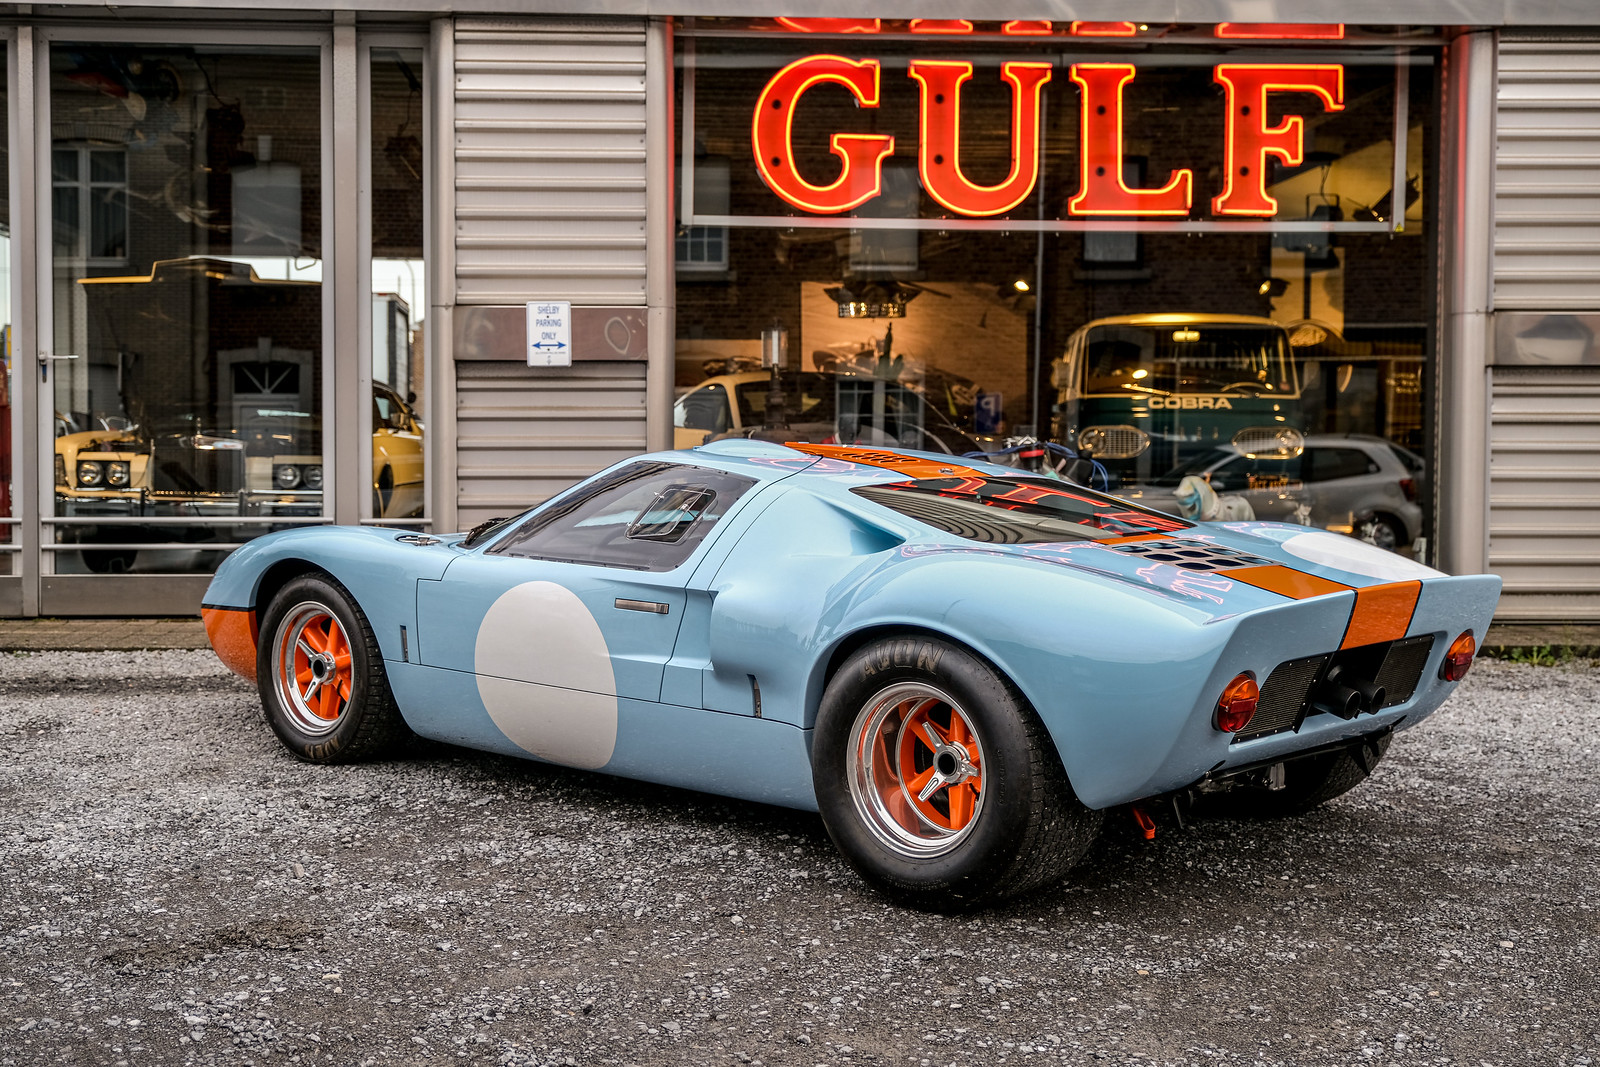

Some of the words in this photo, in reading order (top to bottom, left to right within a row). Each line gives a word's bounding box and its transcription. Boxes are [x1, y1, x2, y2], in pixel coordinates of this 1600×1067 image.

[752, 53, 1346, 217] GULF
[537, 305, 560, 315] SHELBY
[535, 318, 562, 328] PARKING
[541, 331, 557, 340] ONLY
[1148, 396, 1233, 410] COBRA
[859, 639, 946, 682] AVON
